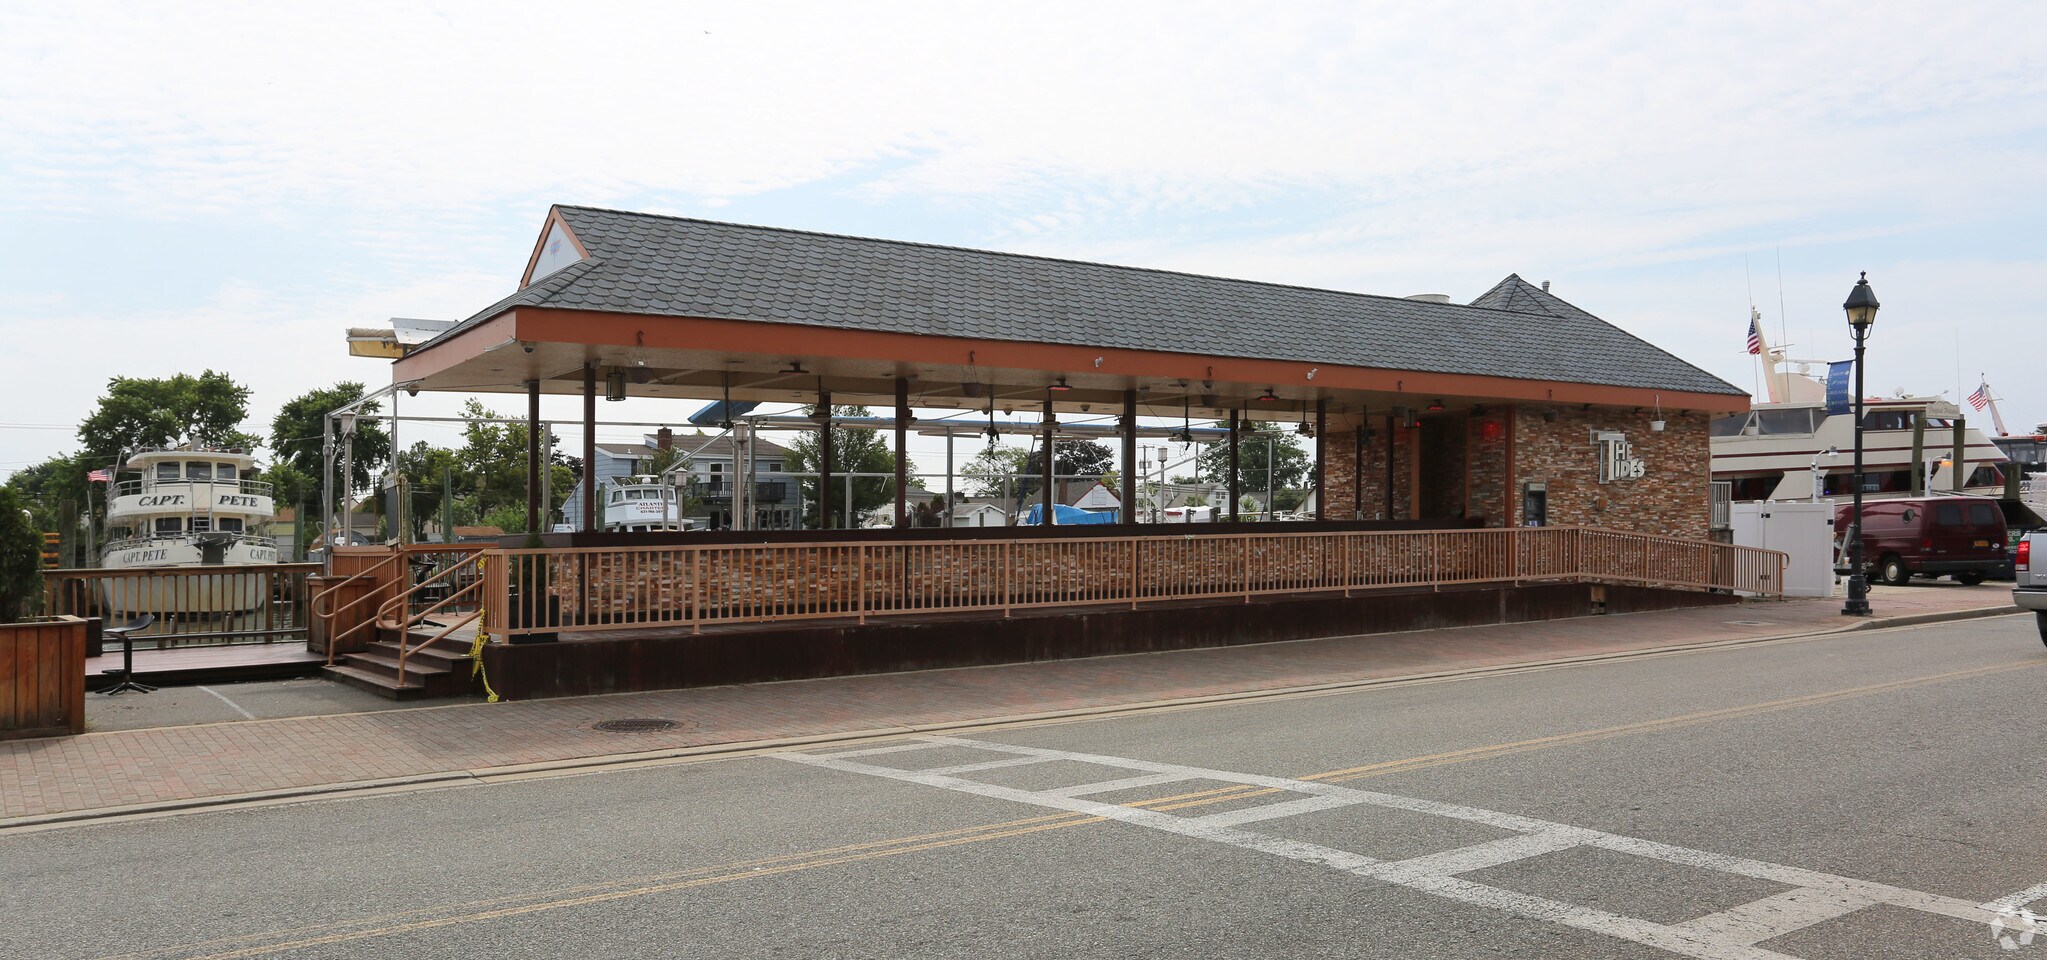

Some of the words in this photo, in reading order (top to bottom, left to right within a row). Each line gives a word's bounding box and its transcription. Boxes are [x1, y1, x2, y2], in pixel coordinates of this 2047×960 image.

[138, 494, 185, 507] CAPT.
[218, 495, 258, 507] PETE
[123, 550, 141, 563] CAPT.
[142, 549, 168, 562] PETE
